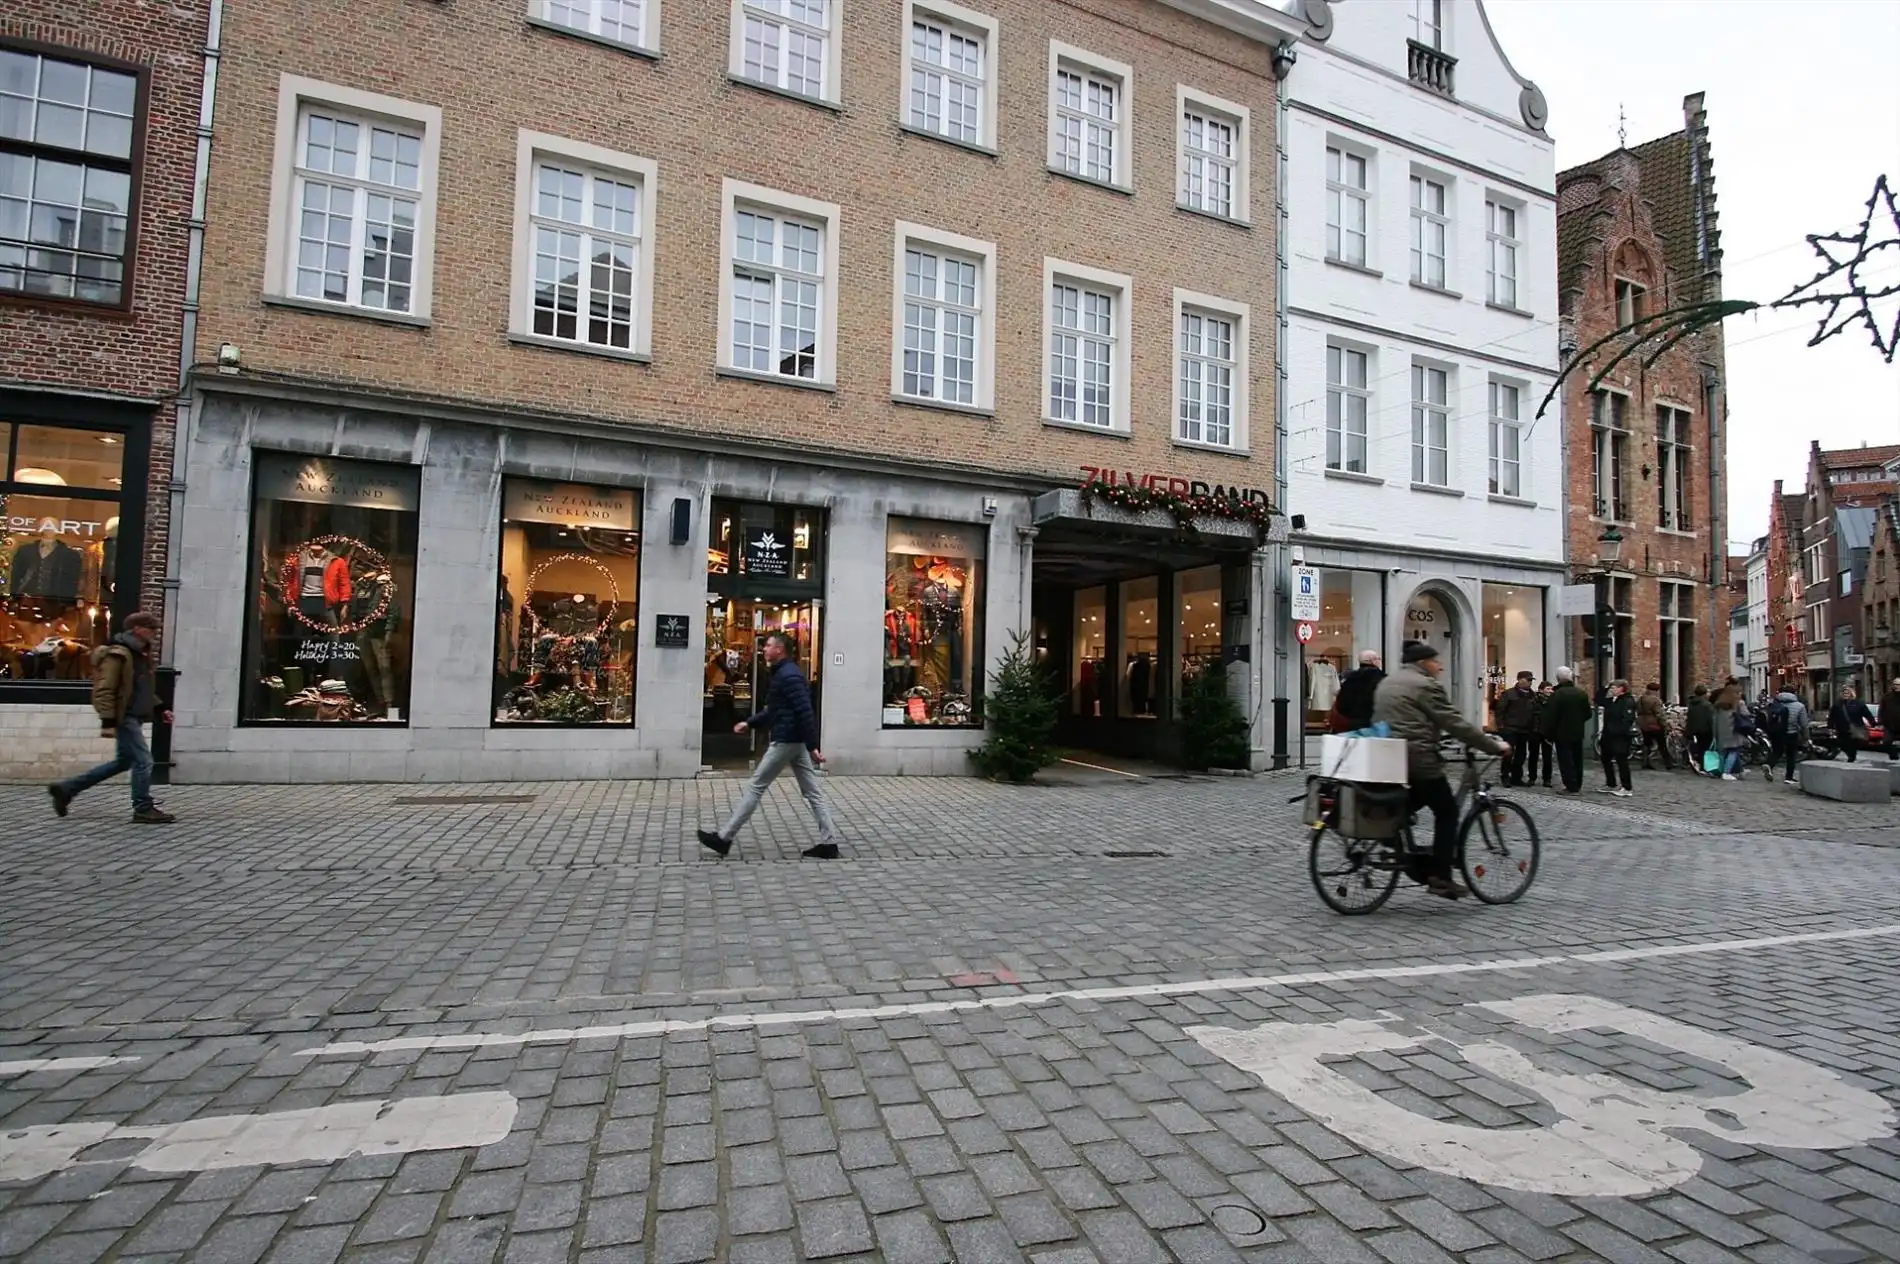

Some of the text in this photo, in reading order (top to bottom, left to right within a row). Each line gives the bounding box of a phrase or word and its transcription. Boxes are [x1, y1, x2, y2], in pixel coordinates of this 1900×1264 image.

[536, 504, 610, 520] AUCKLAND
[11, 516, 37, 527] OF
[38, 519, 102, 537] ART
[1298, 568, 1314, 576] ZONE
[1408, 609, 1435, 622] COS
